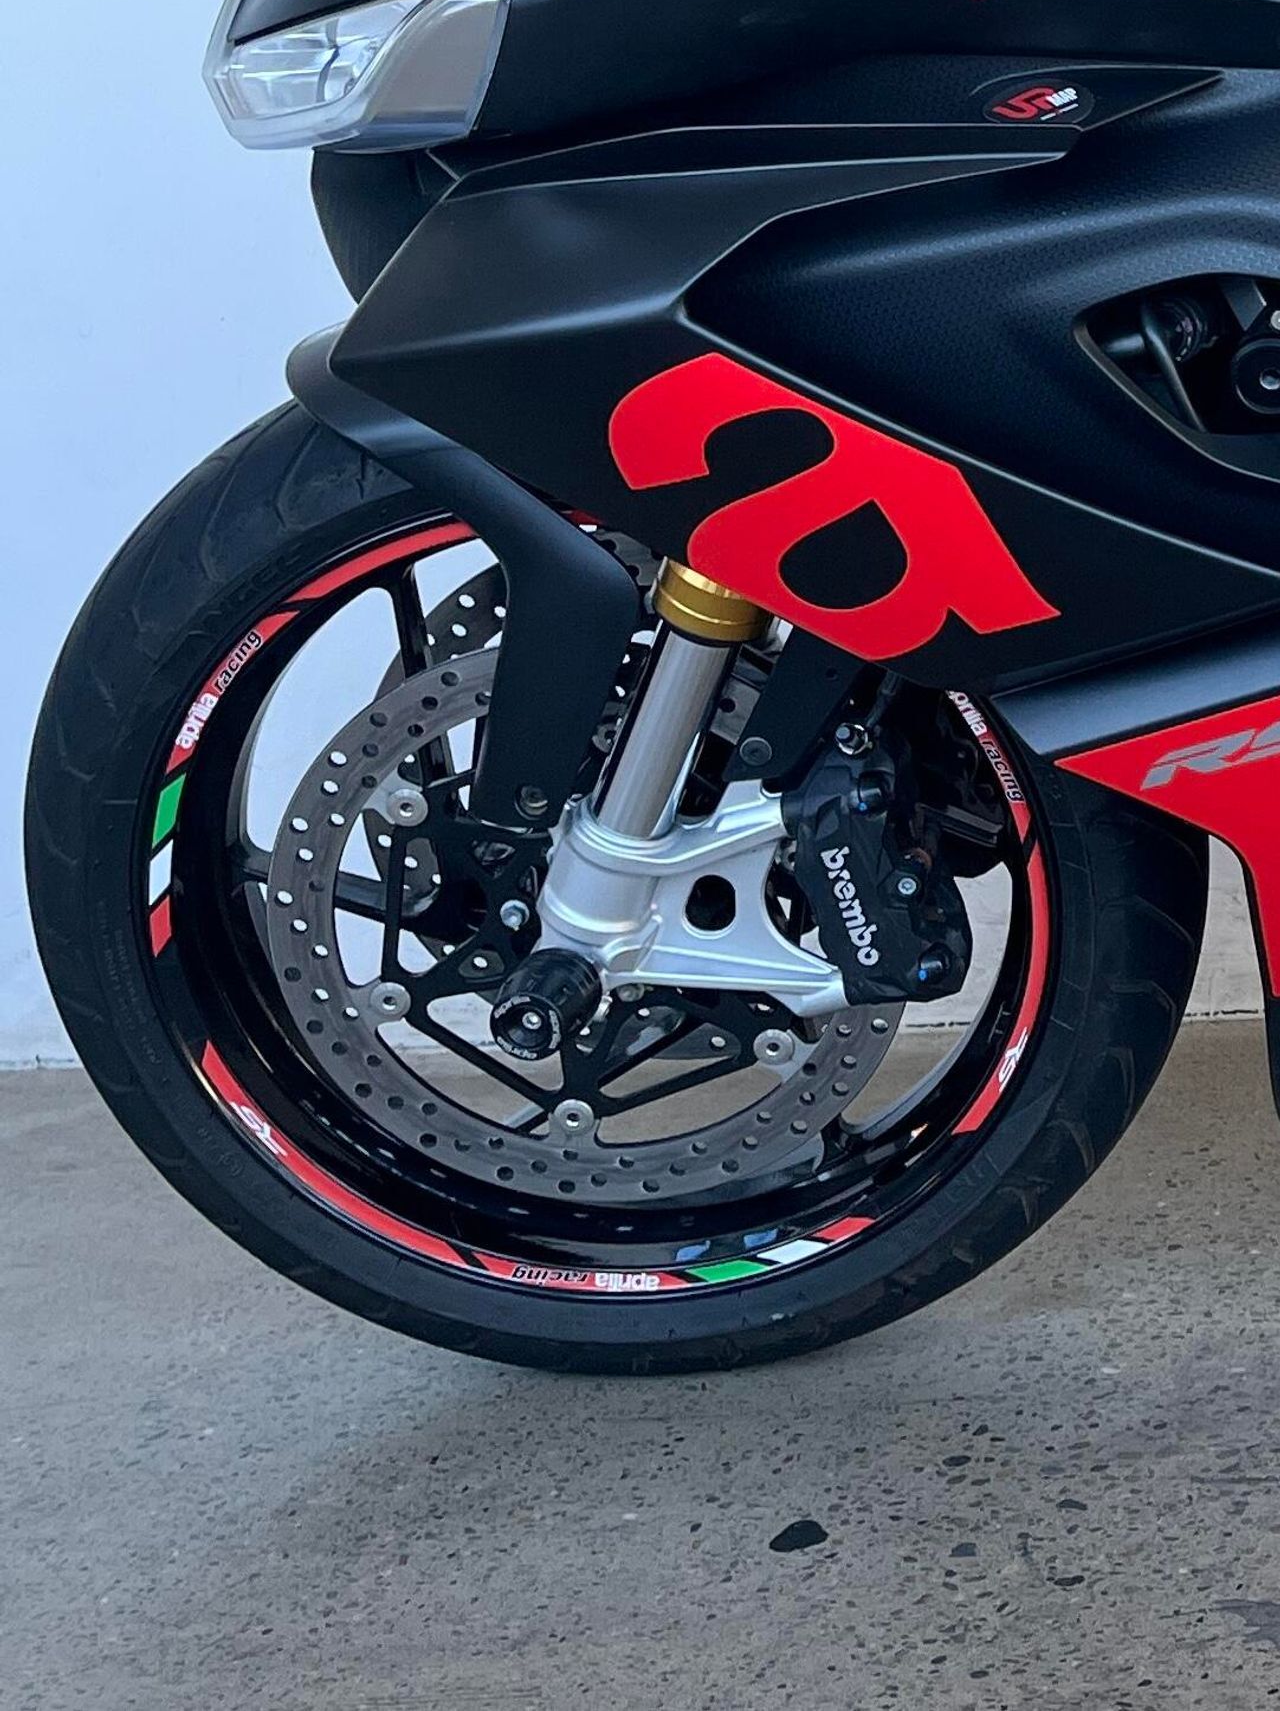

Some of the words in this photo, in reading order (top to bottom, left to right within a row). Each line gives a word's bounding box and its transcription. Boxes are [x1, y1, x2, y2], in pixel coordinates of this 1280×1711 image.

[213, 629, 262, 693] racing
[980, 738, 1026, 803] racing
[820, 846, 880, 967] brembo
[510, 1264, 590, 1287] racing
